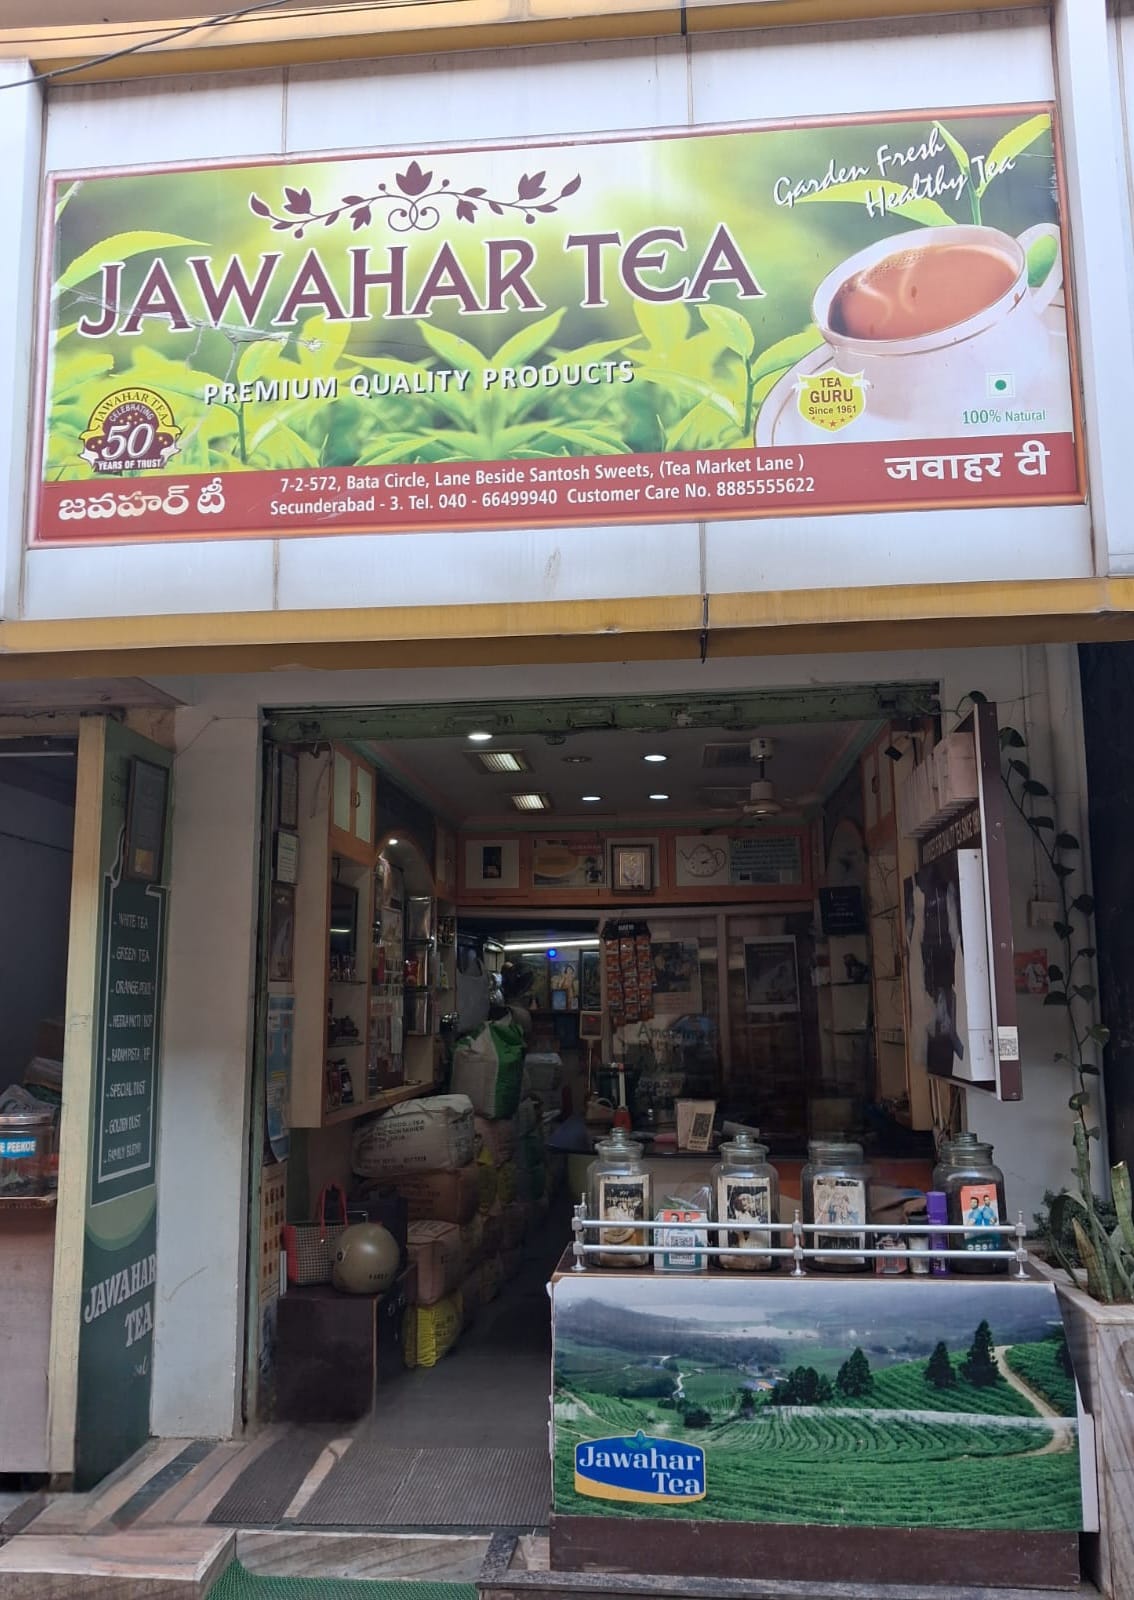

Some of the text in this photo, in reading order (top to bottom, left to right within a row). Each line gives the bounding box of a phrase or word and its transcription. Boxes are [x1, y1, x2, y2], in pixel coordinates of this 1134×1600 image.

[773, 128, 945, 207] Garden Fresh
[866, 155, 1015, 217] Healthy Tea
[79, 223, 766, 337] JAWAHAR TEA
[204, 361, 635, 405] PREMIUM QUALITY PRODUCTS
[810, 389, 853, 403] GURU
[820, 377, 842, 388] TEA
[94, 392, 169, 423] JAWAHAR TEA
[109, 404, 155, 422] CELEBRATING
[808, 405, 857, 415] Since 1961
[962, 409, 1046, 424] 100% Natural
[101, 423, 155, 460] 50
[98, 459, 161, 471] YEARS OF TRUST
[280, 476, 342, 493] 7-2-572,
[347, 475, 379, 490] Bata
[384, 472, 430, 489] Circle,
[435, 471, 470, 486] Lane
[475, 467, 525, 484] Beside
[530, 464, 589, 483] Santosh
[595, 462, 654, 480] Sweets,
[660, 460, 690, 478] (Tea
[696, 457, 751, 475] Market
[756, 456, 793, 472] Lane
[884, 440, 1050, 482] जवाहर टी
[58, 477, 225, 520] జవహర్ టీ
[270, 496, 375, 515] Secunderabad
[390, 496, 403, 511] 3.
[409, 494, 433, 510] Tel.
[439, 493, 467, 509] 040
[481, 489, 558, 507] 66499940
[567, 487, 640, 504] Customer
[644, 485, 680, 501] Care
[685, 483, 711, 498] No.
[716, 477, 815, 496] 8885555622
[124, 1301, 154, 1348] TEA
[579, 1446, 700, 1471] Jawahar
[652, 1471, 700, 1494] Tea
